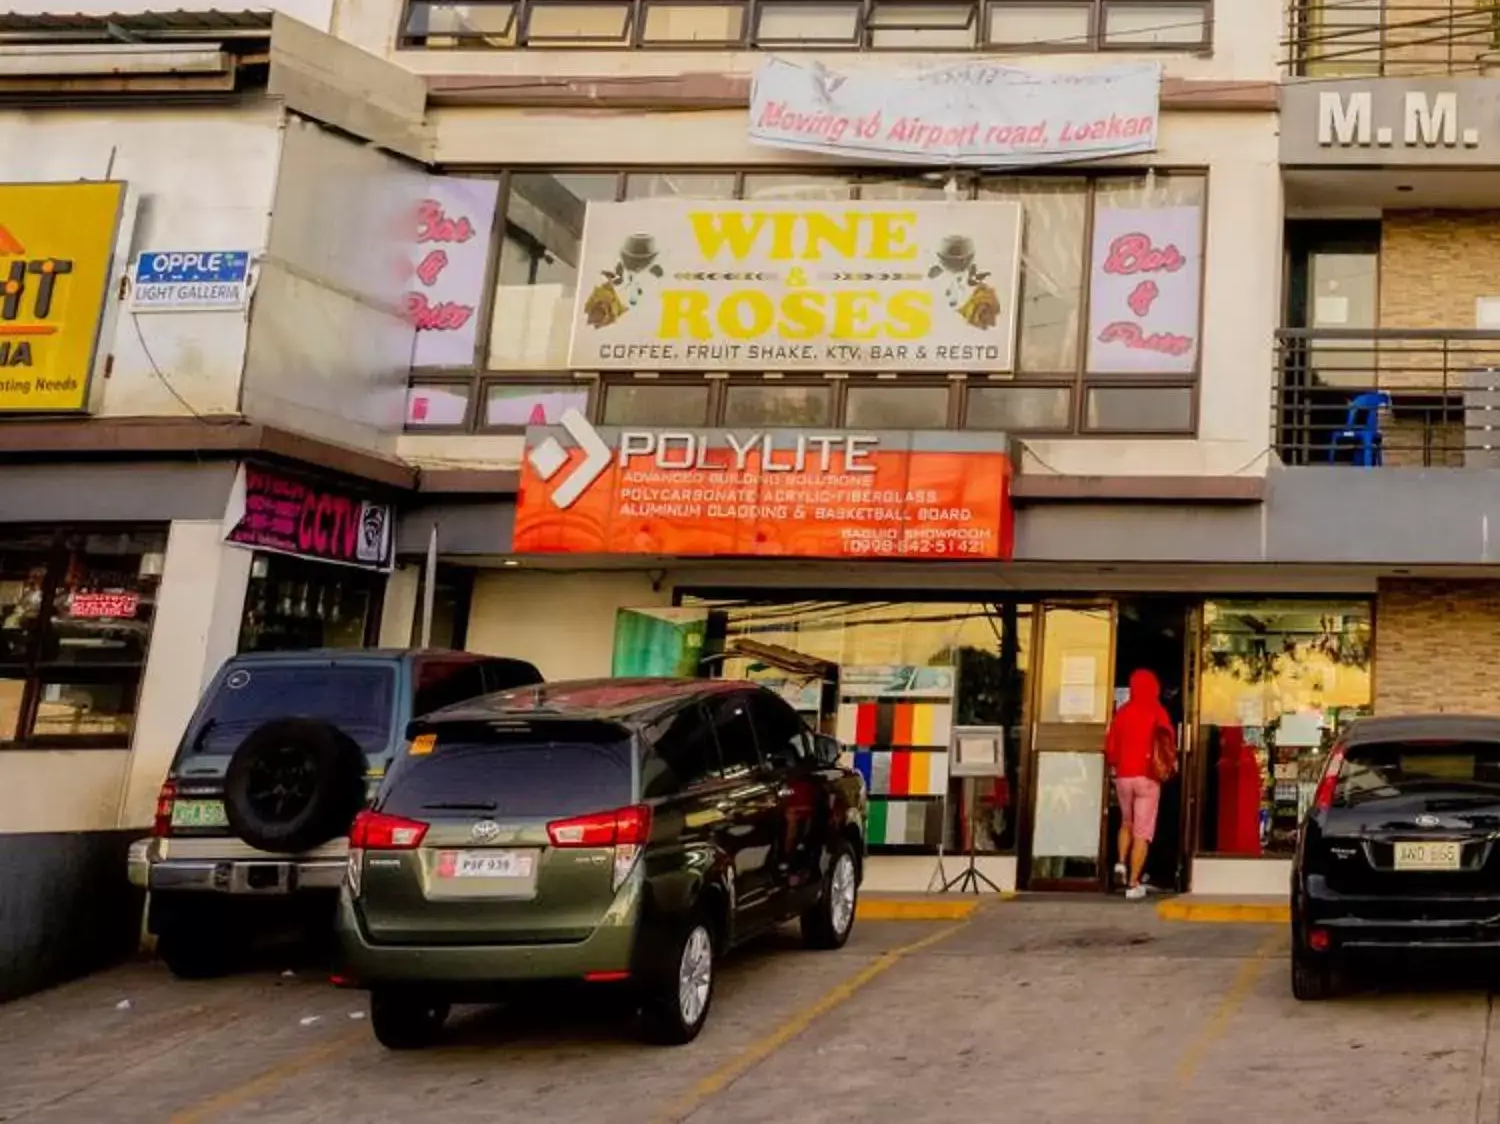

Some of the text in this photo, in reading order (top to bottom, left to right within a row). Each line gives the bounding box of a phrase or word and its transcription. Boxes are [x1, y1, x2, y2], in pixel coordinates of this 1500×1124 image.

[757, 100, 848, 143] Moving
[888, 116, 980, 148] Airport
[984, 119, 1049, 151] road,
[1317, 90, 1479, 148] M.M.
[687, 211, 918, 260] WINE
[152, 253, 222, 273] OPPLE
[783, 267, 809, 287] &
[136, 284, 174, 301] LIGHT
[657, 289, 935, 340] ROSES
[687, 344, 741, 362] FRUIT
[871, 345, 907, 363] BAR
[915, 346, 928, 363] &
[937, 345, 1000, 363] RESTO
[619, 431, 880, 473] POLYLITE
[620, 489, 757, 503] POLYCARBONATE
[299, 490, 362, 558] CCTV
[620, 504, 702, 518] ALUMINUM
[815, 506, 912, 522] BASKETBALL
[917, 507, 973, 522] BOARD
